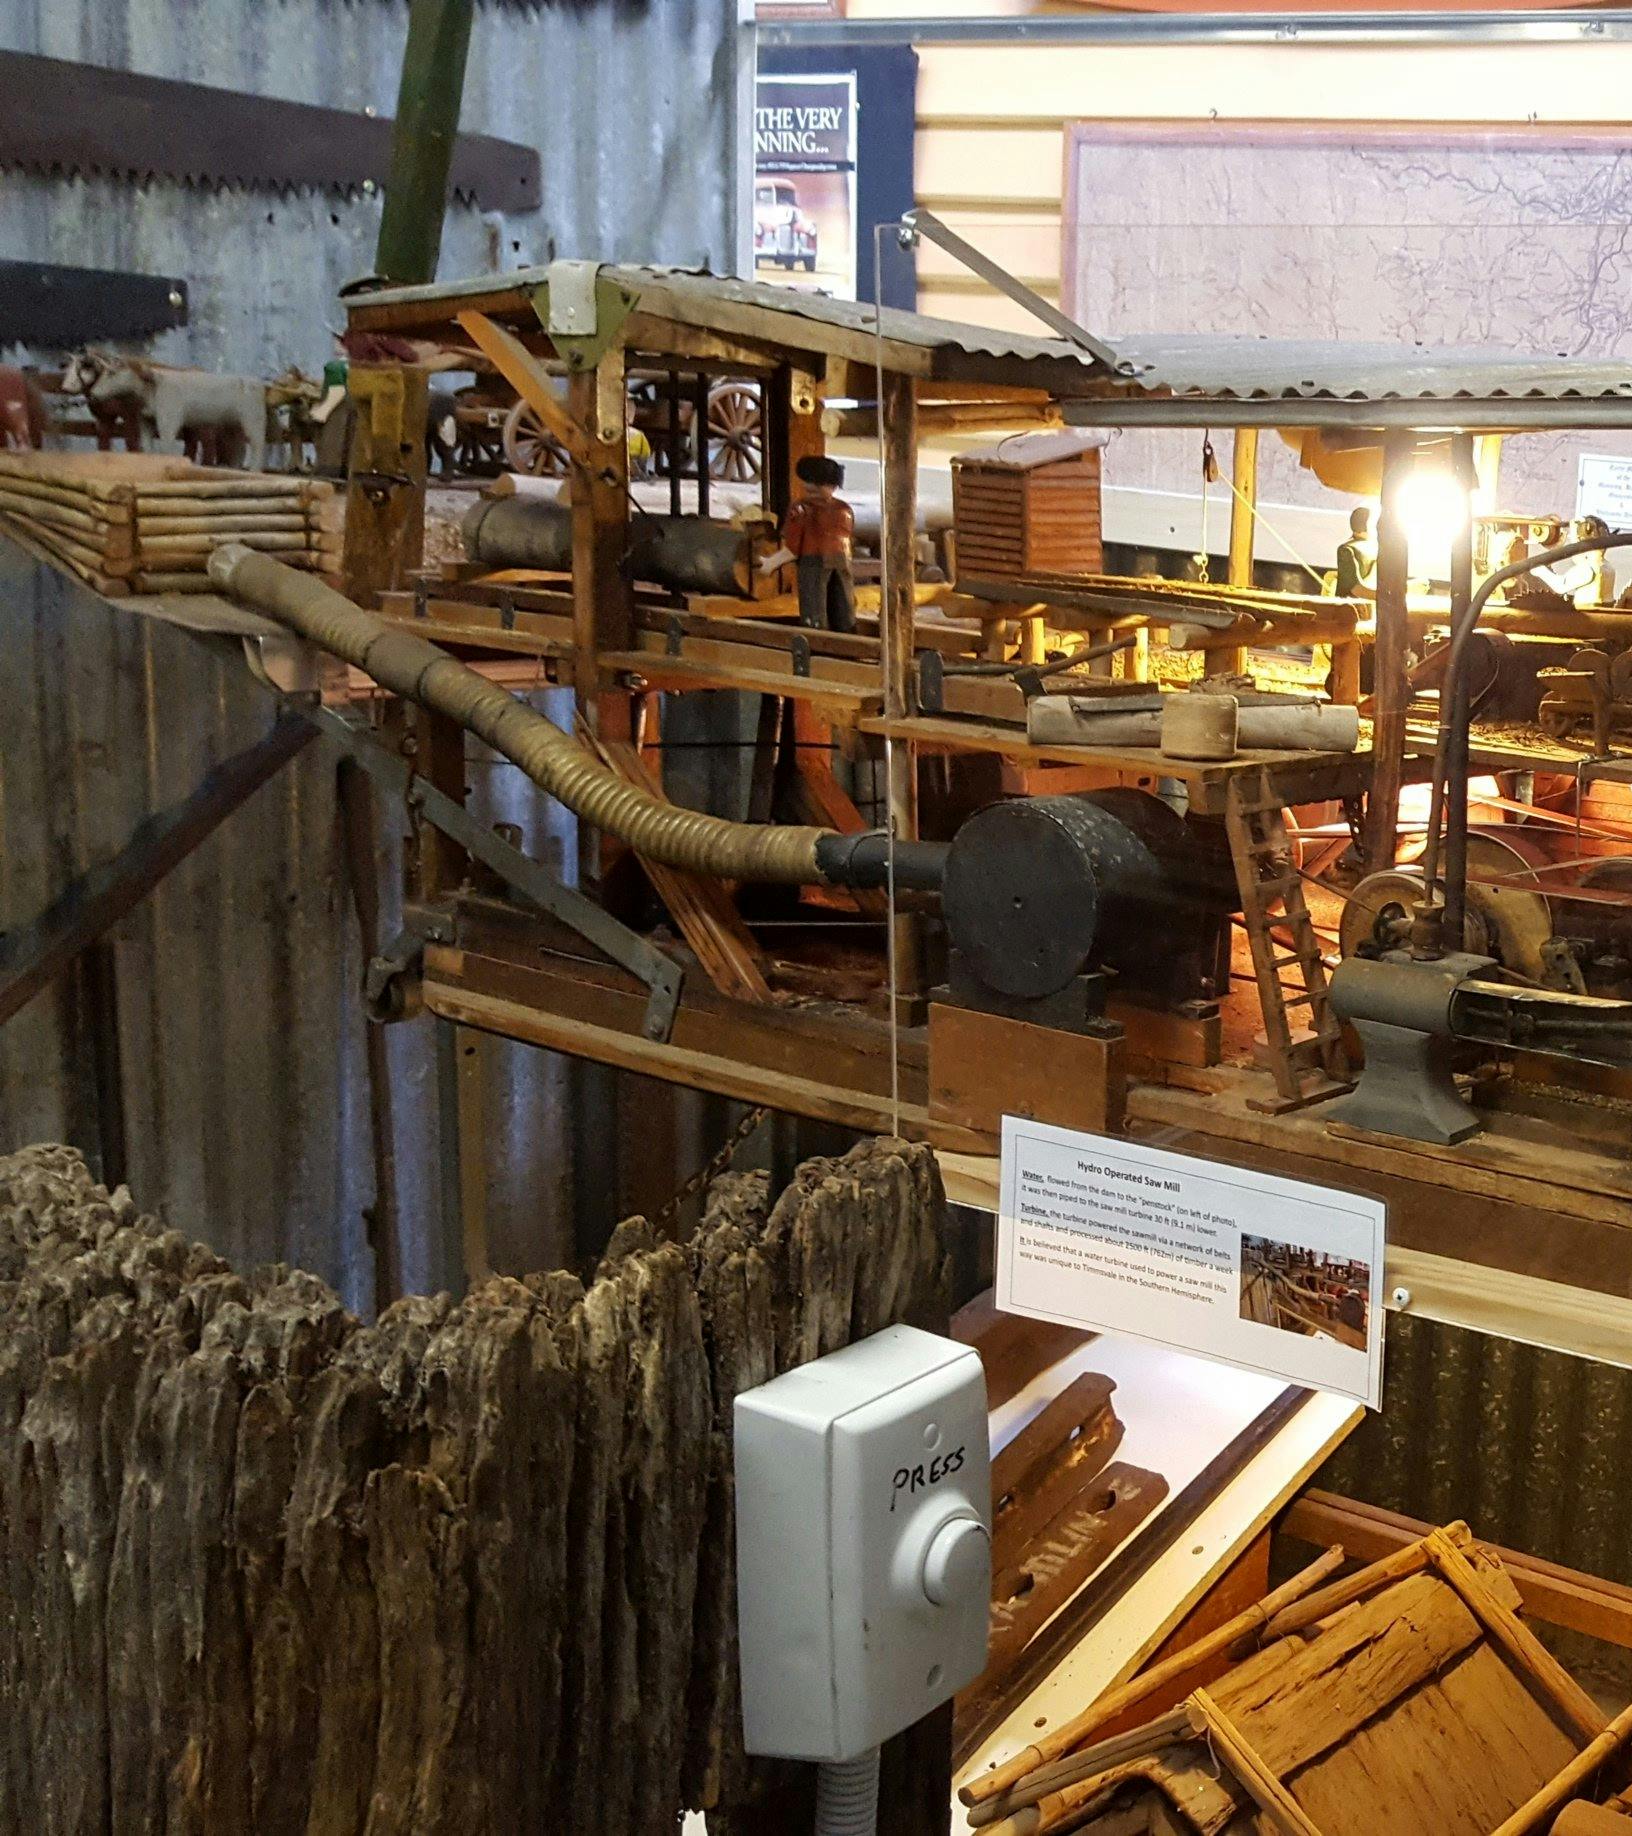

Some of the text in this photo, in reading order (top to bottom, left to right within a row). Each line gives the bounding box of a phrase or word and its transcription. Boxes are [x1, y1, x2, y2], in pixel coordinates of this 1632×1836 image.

[758, 107, 842, 130] THE VERY
[1046, 1174, 1070, 1187] flowed
[1070, 1179, 1087, 1192] from
[1087, 1184, 1099, 1194] the
[1100, 1188, 1116, 1199] dam
[1116, 1191, 1124, 1200] to
[1124, 1192, 1137, 1204] the
[1189, 1208, 1201, 1219] left
[1201, 1211, 1210, 1220] of
[1077, 1160, 1180, 1192] Hydro Operated Saw Mill
[1018, 1234, 1227, 1293] It is believed that a water turbine used to power a saw mill this
[890, 1447, 965, 1511] PRESS
